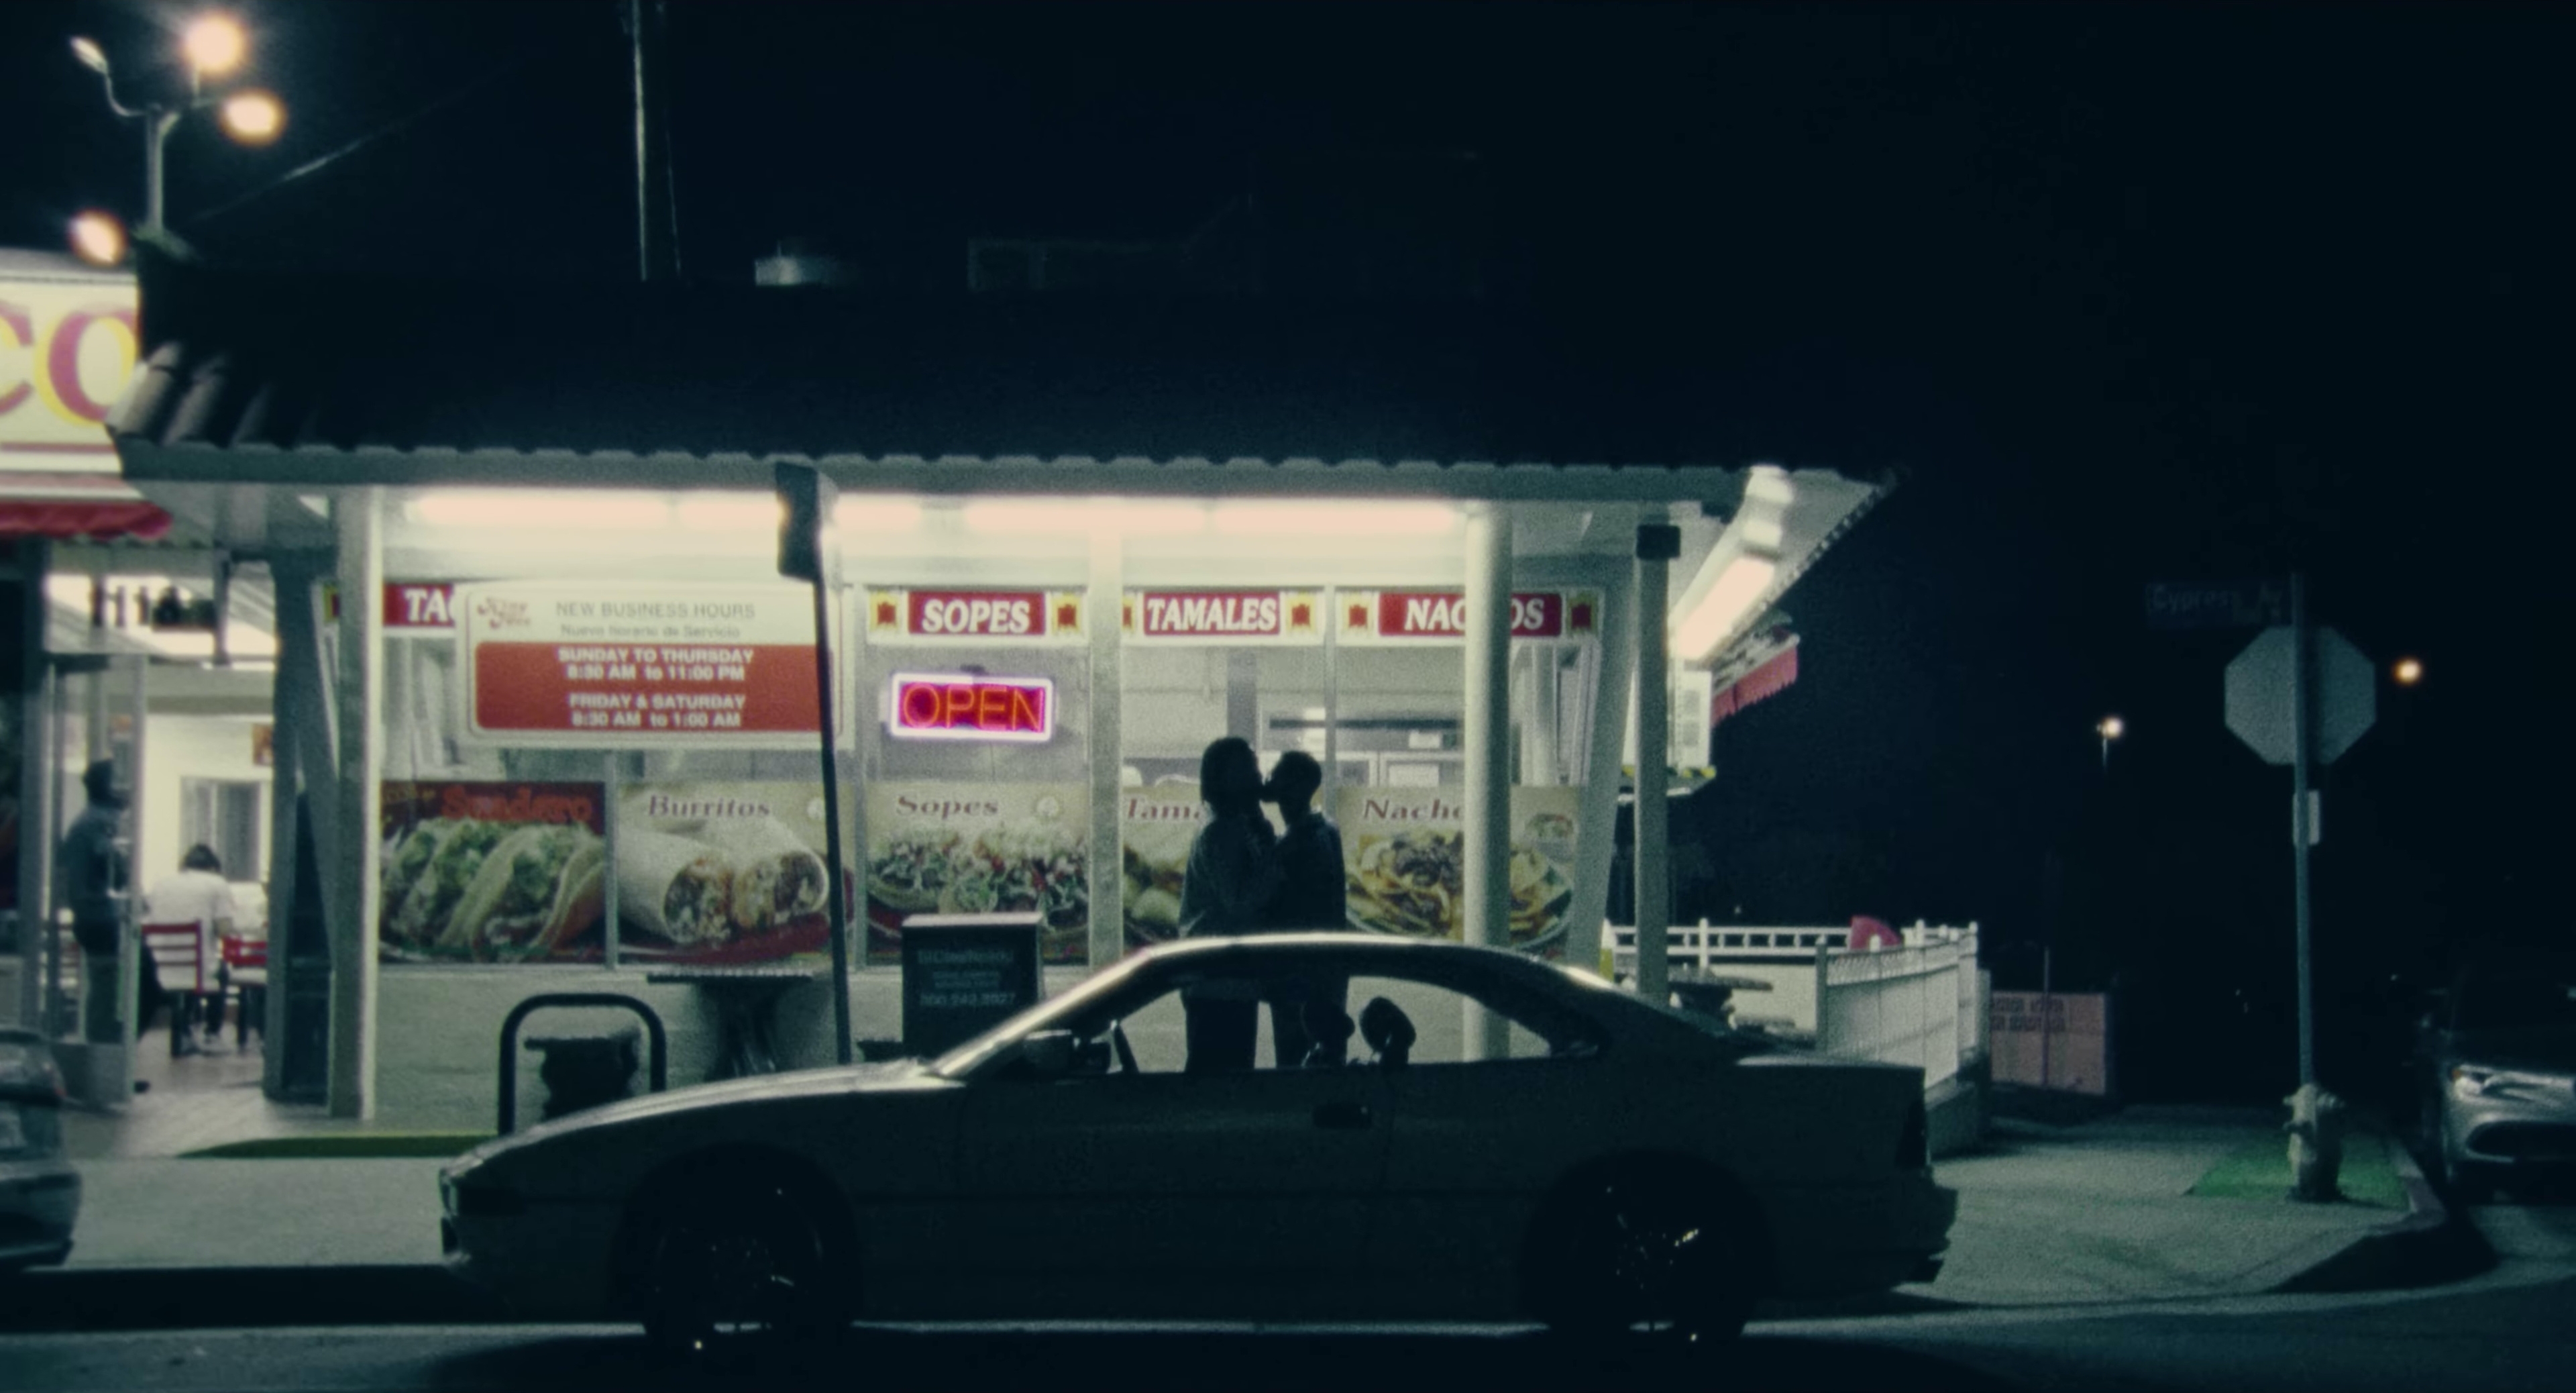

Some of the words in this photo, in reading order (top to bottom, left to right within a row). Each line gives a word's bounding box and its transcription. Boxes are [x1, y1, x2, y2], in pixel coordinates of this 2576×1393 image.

[404, 588, 455, 622] TA
[557, 602, 595, 617] NEW
[601, 602, 688, 618] BUSINESS
[694, 603, 755, 619] HOURS
[922, 599, 1030, 633] SOPES
[1147, 598, 1277, 631] TAMALES
[1403, 597, 1544, 631] NACOS
[558, 648, 629, 662] SUNDAY
[633, 648, 657, 662] TO
[661, 648, 753, 663] THURSDAY
[567, 664, 604, 679] 8:30
[608, 664, 636, 679] AM
[645, 665, 663, 680] to
[668, 665, 713, 680] 11:00
[717, 665, 745, 680] PM
[569, 693, 631, 708] FRIDAY
[636, 693, 648, 708] &
[651, 694, 745, 709] SATURDAY
[903, 682, 1044, 733] OPEN
[572, 711, 608, 726] 8:30
[612, 711, 641, 726] AM
[649, 712, 667, 726] to
[673, 712, 708, 727] 1:00
[712, 712, 741, 727] AM
[648, 795, 770, 817] Burritos
[896, 794, 998, 820] Sopes
